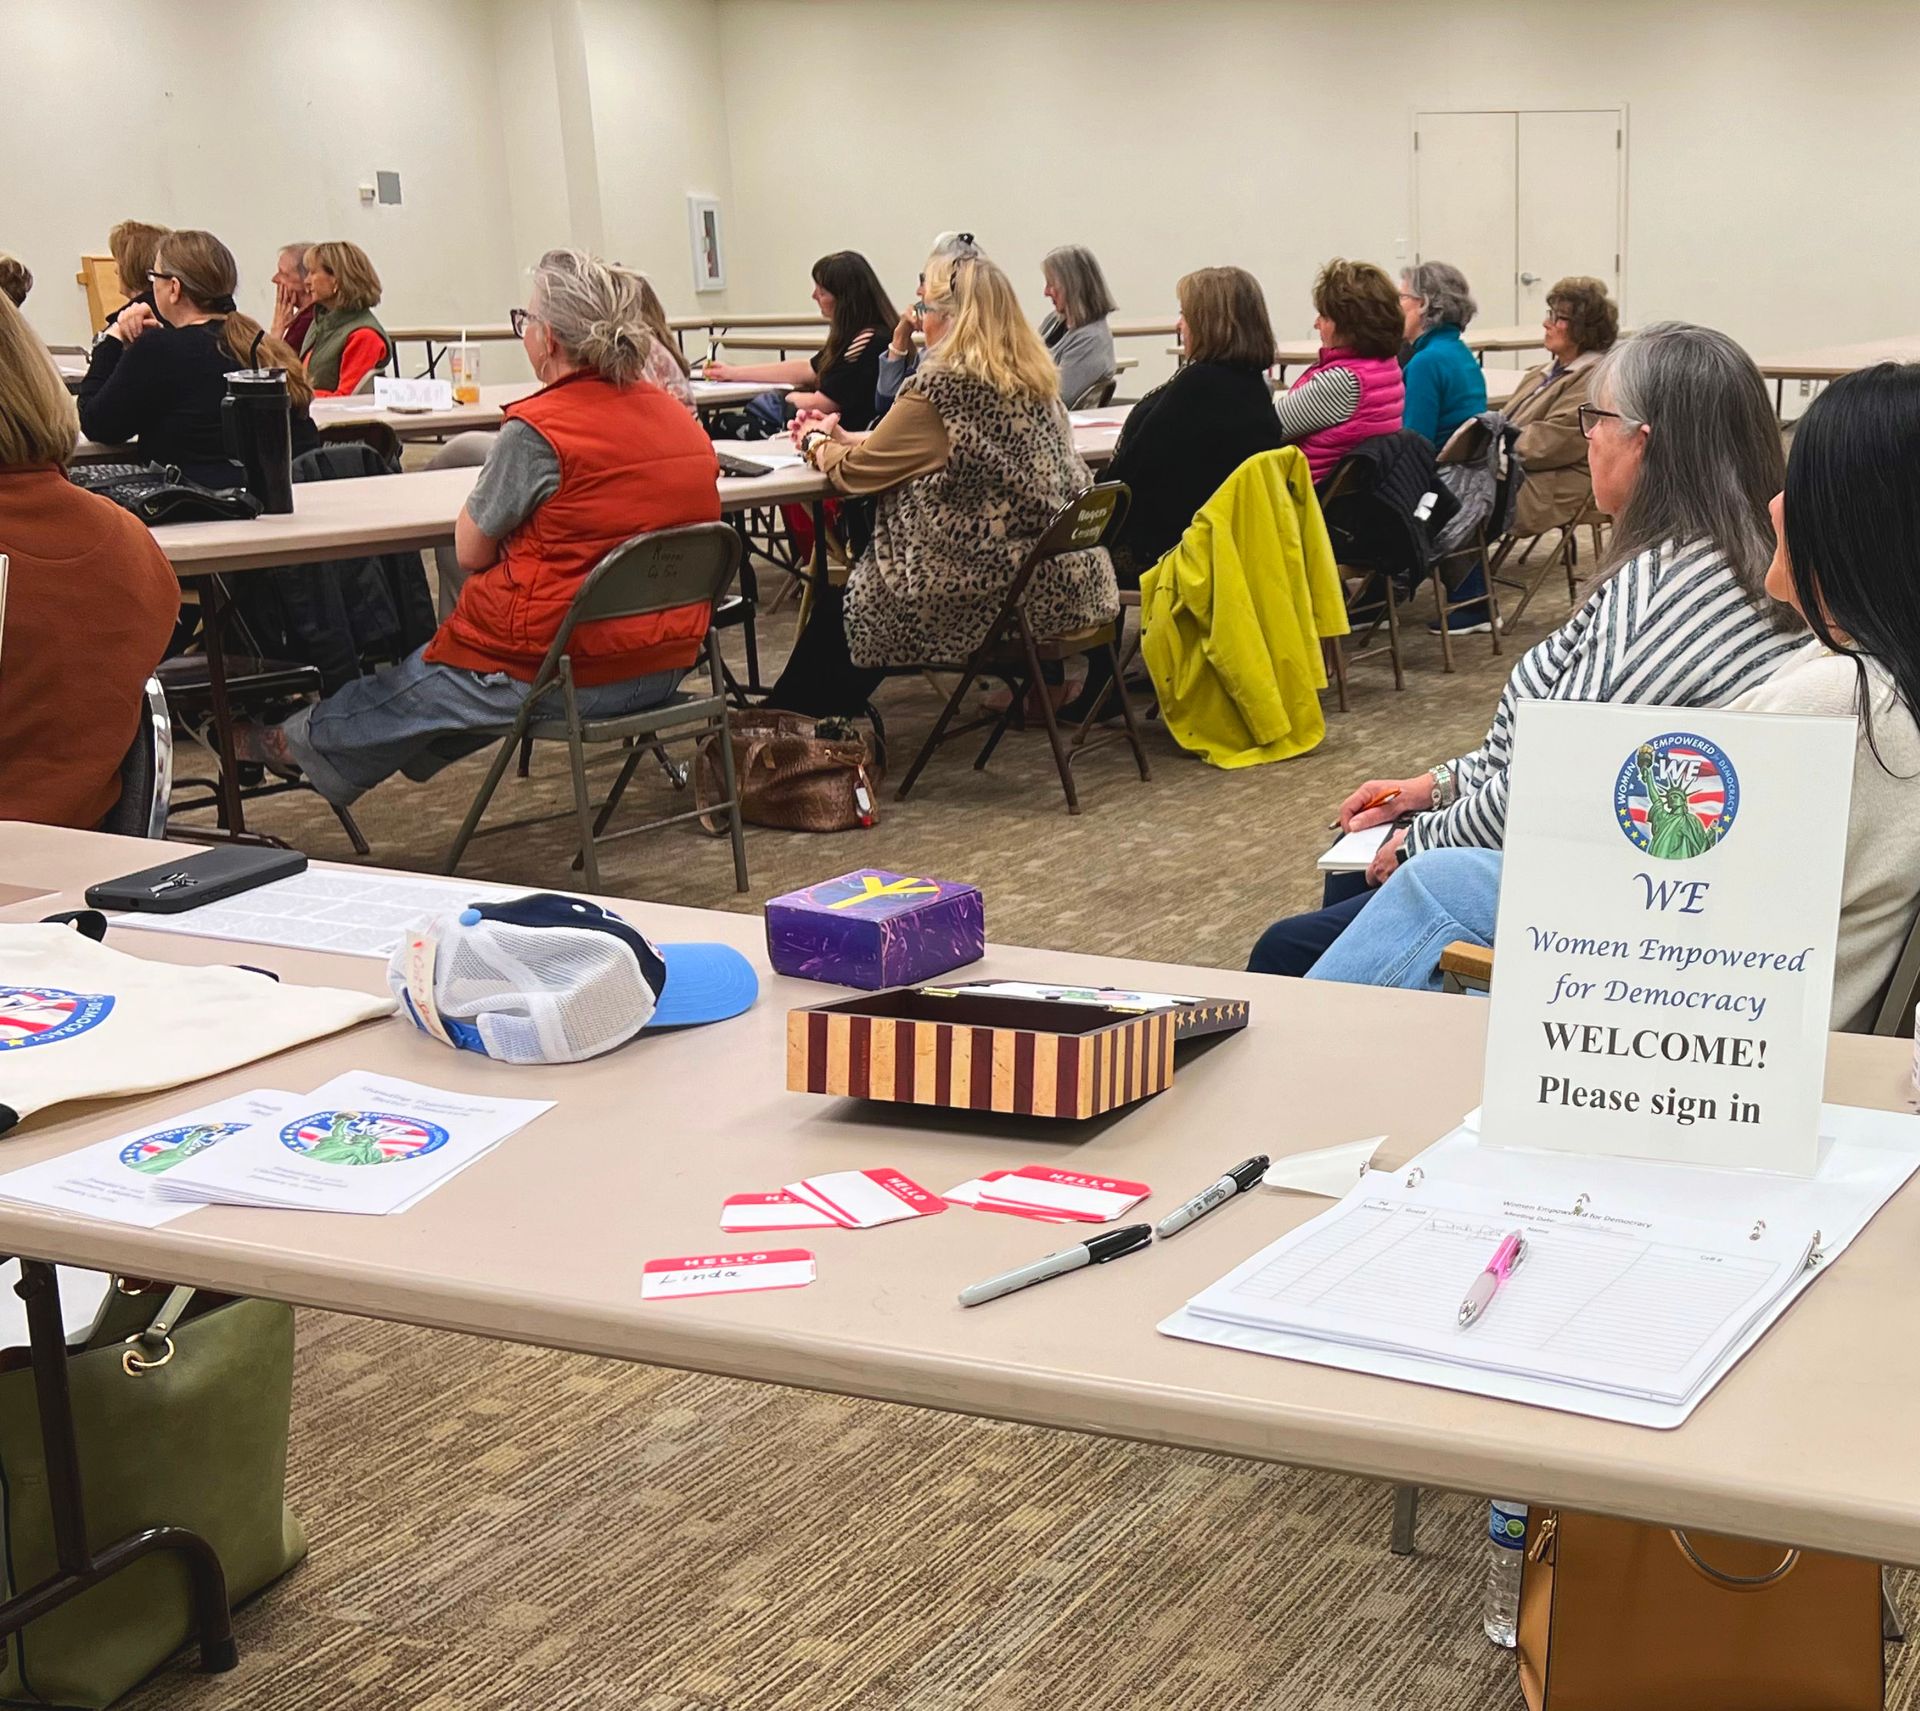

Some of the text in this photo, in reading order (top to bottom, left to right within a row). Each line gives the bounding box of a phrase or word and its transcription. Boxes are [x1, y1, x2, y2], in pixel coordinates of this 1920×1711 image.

[1618, 762, 1636, 804] WOMEN
[1653, 736, 1715, 755] EMPOWERED
[1718, 759, 1735, 812] DEMOCRACY
[1659, 759, 1702, 781] WE
[1632, 872, 1711, 914] WE
[1525, 926, 1815, 973] Women Empowered
[1546, 973, 1767, 1022] for Democracy
[1541, 1021, 1767, 1069] WELCOME!
[1536, 1074, 1761, 1127] Please sign in
[886, 1177, 928, 1201] HELLO
[1048, 1173, 1117, 1188] HELLO
[1603, 1215, 1653, 1229] Democracy
[684, 1253, 768, 1267] HELLO
[659, 1269, 742, 1285] Linda
